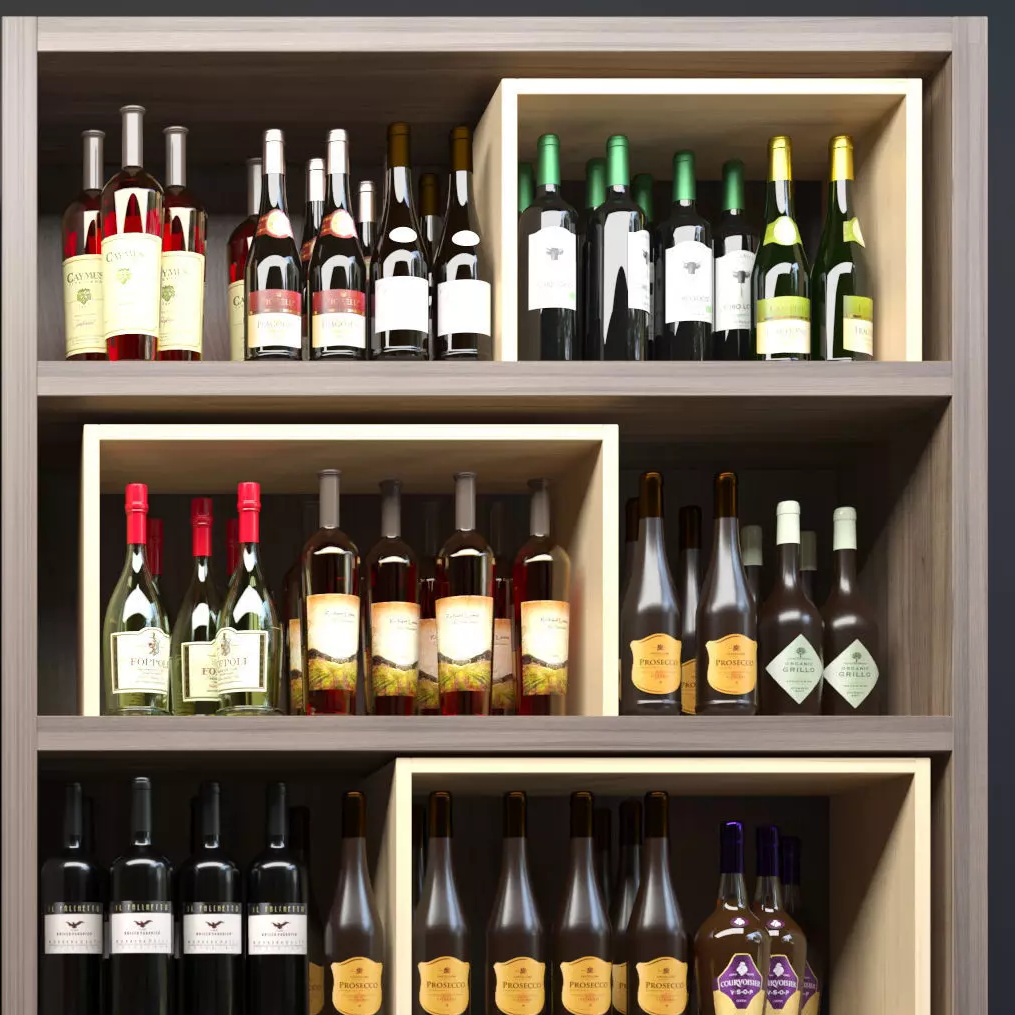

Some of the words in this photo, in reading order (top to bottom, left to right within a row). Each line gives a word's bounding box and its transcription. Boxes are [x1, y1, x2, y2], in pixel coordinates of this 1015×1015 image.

[639, 658, 679, 667] PROSECCO
[715, 658, 754, 667] PROSECCO
[339, 981, 378, 989] PROSECCO
[426, 981, 465, 989] PROSECCO
[502, 981, 542, 989] PROSECCO
[569, 981, 608, 989] PROSECCO
[645, 981, 684, 989] PROSECCO
[720, 978, 761, 988] COURVOISIER
